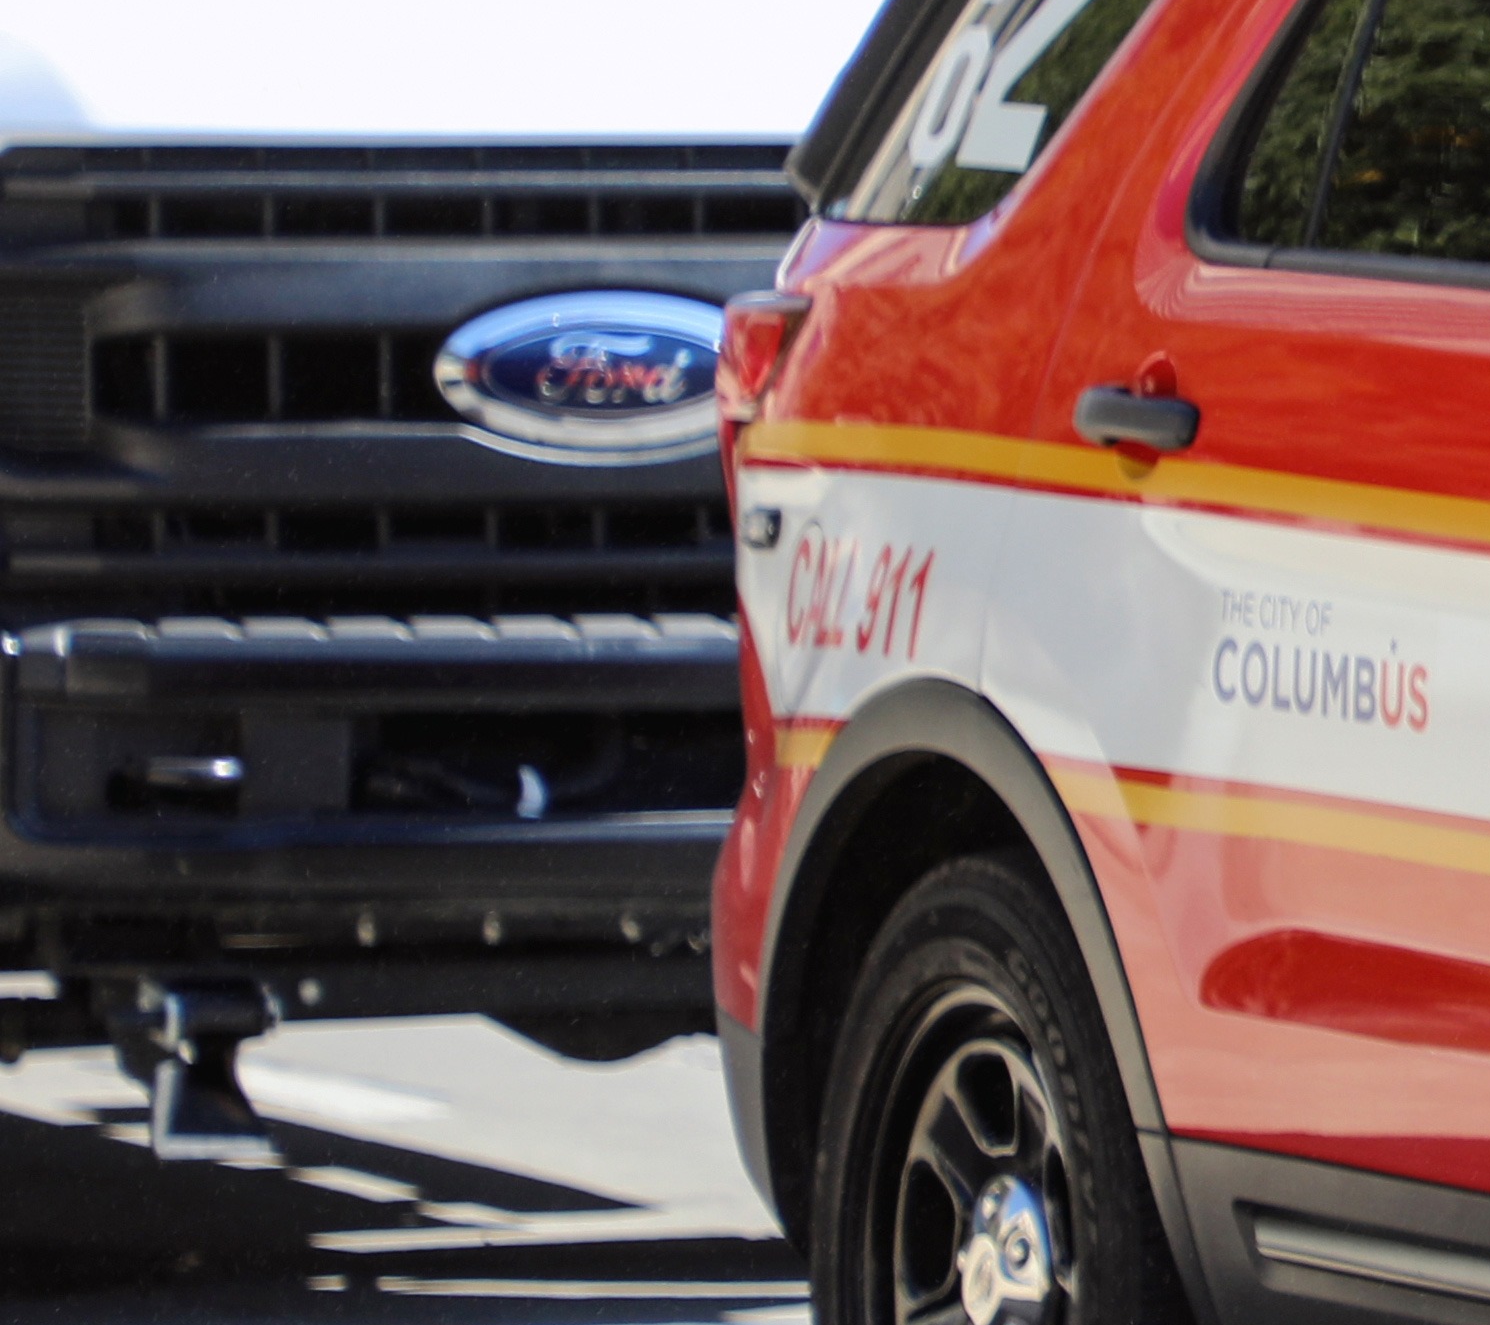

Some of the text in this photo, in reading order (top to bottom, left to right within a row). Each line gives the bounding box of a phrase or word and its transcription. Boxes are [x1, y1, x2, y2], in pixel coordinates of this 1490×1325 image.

[537, 332, 687, 404] Ford
[787, 538, 936, 663] CALL 911
[1220, 587, 1334, 636] THE CITY OF
[1212, 636, 1430, 734] COLUMBUS
